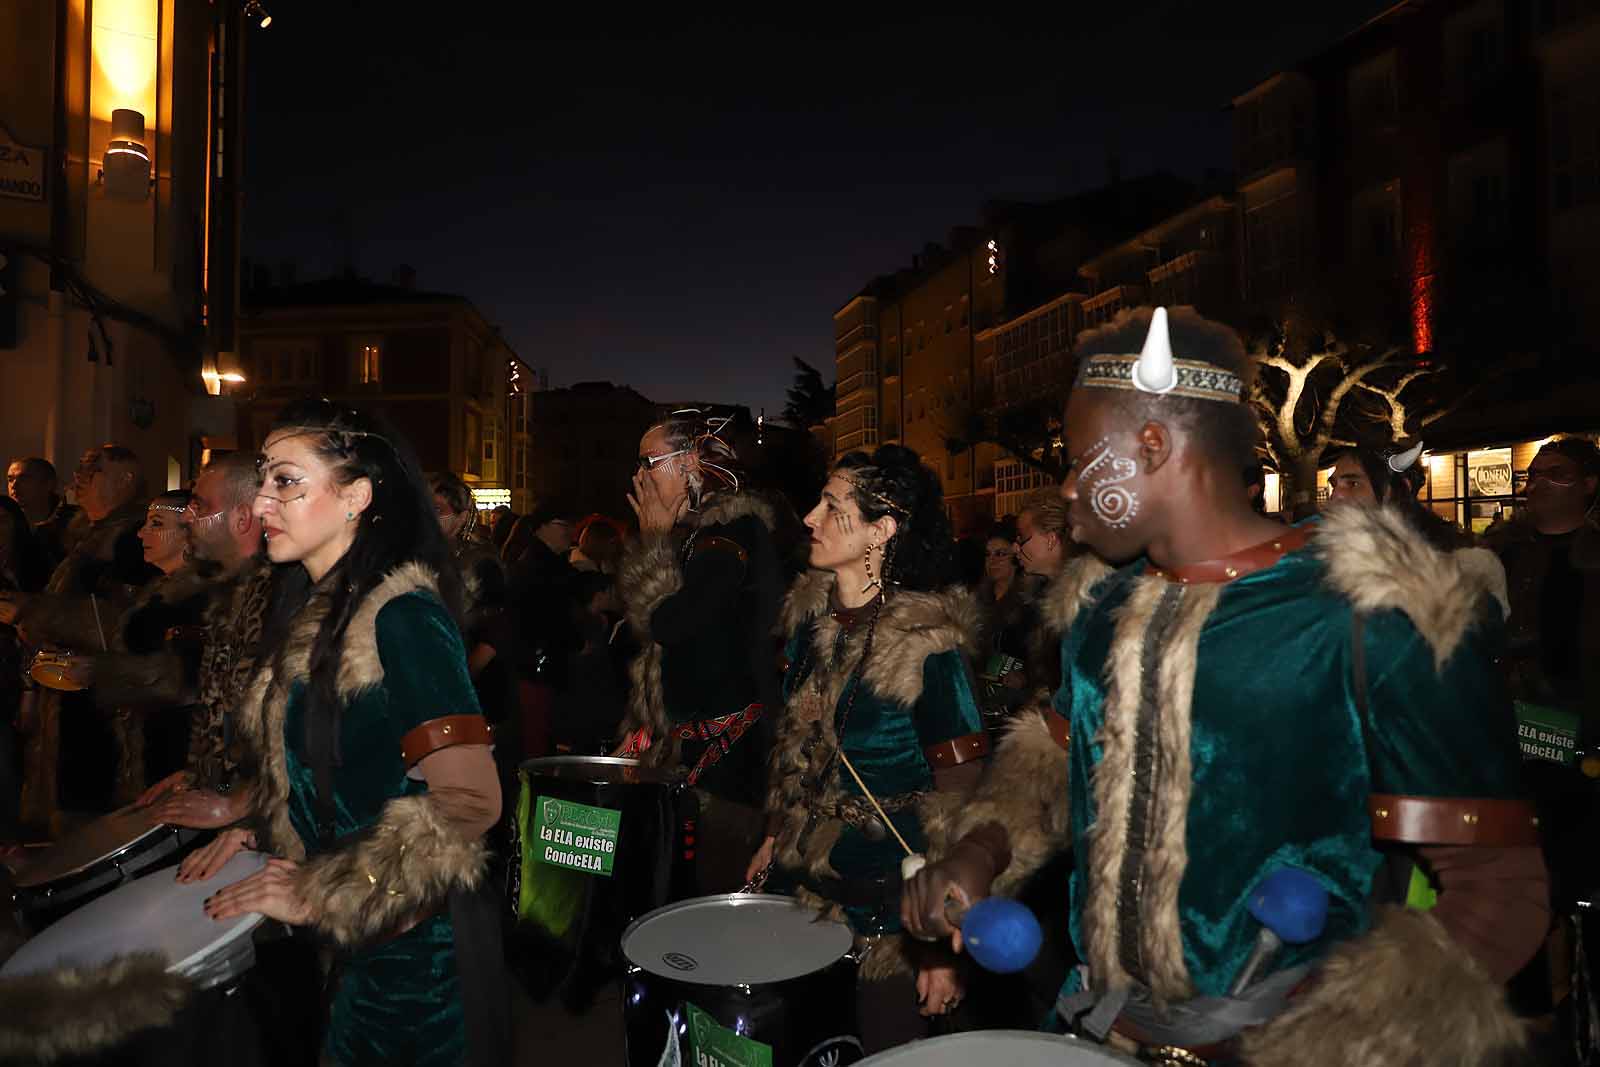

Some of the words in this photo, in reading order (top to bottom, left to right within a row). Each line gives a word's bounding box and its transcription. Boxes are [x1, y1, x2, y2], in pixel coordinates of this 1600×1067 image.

[1518, 724, 1537, 739] ELA
[1538, 731, 1575, 749] existe
[540, 825, 553, 841] La
[554, 828, 573, 846] ELA
[574, 835, 614, 853] existe
[544, 846, 602, 871] ConócELA
